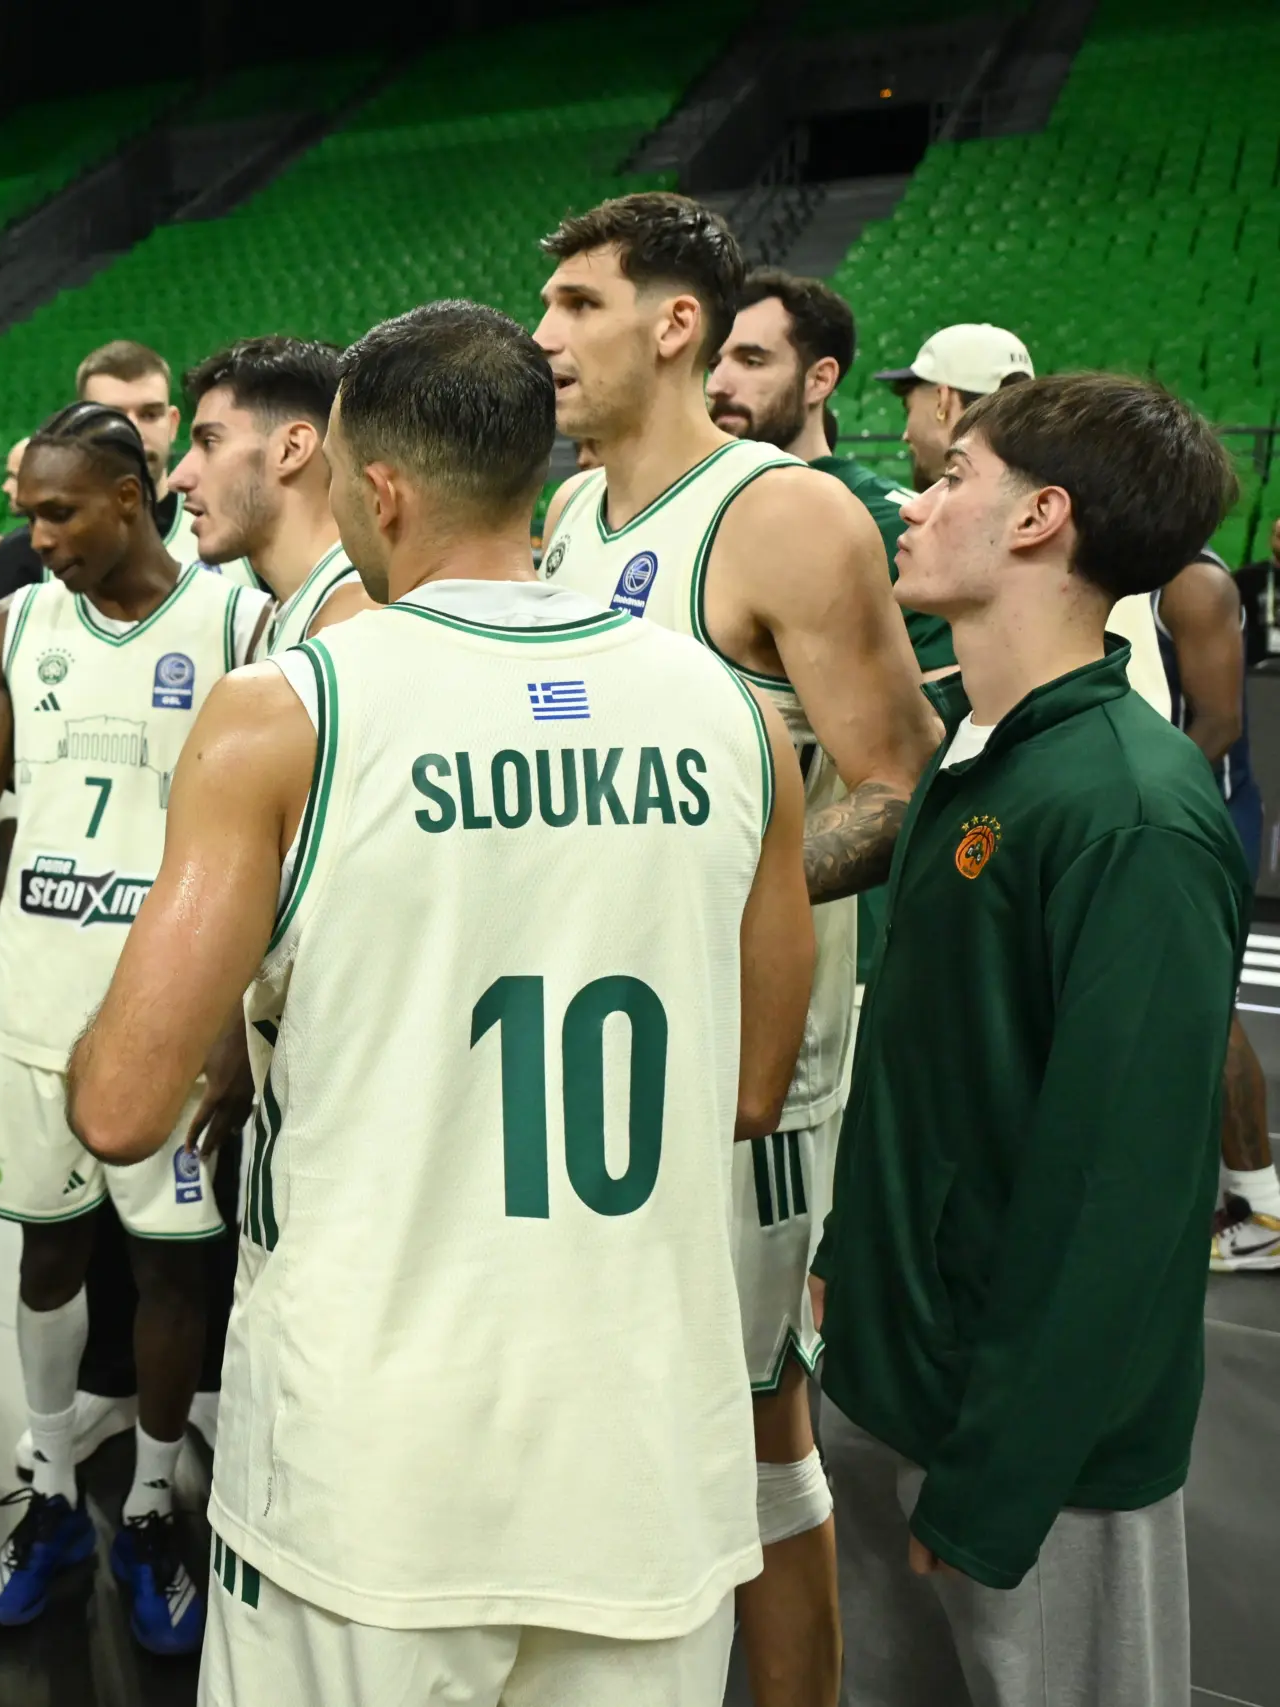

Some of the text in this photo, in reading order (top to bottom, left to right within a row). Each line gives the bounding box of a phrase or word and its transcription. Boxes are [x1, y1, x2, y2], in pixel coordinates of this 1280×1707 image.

[85, 776, 113, 839] 7
[411, 746, 711, 834] SLOUKAS
[469, 974, 669, 1220] 10
